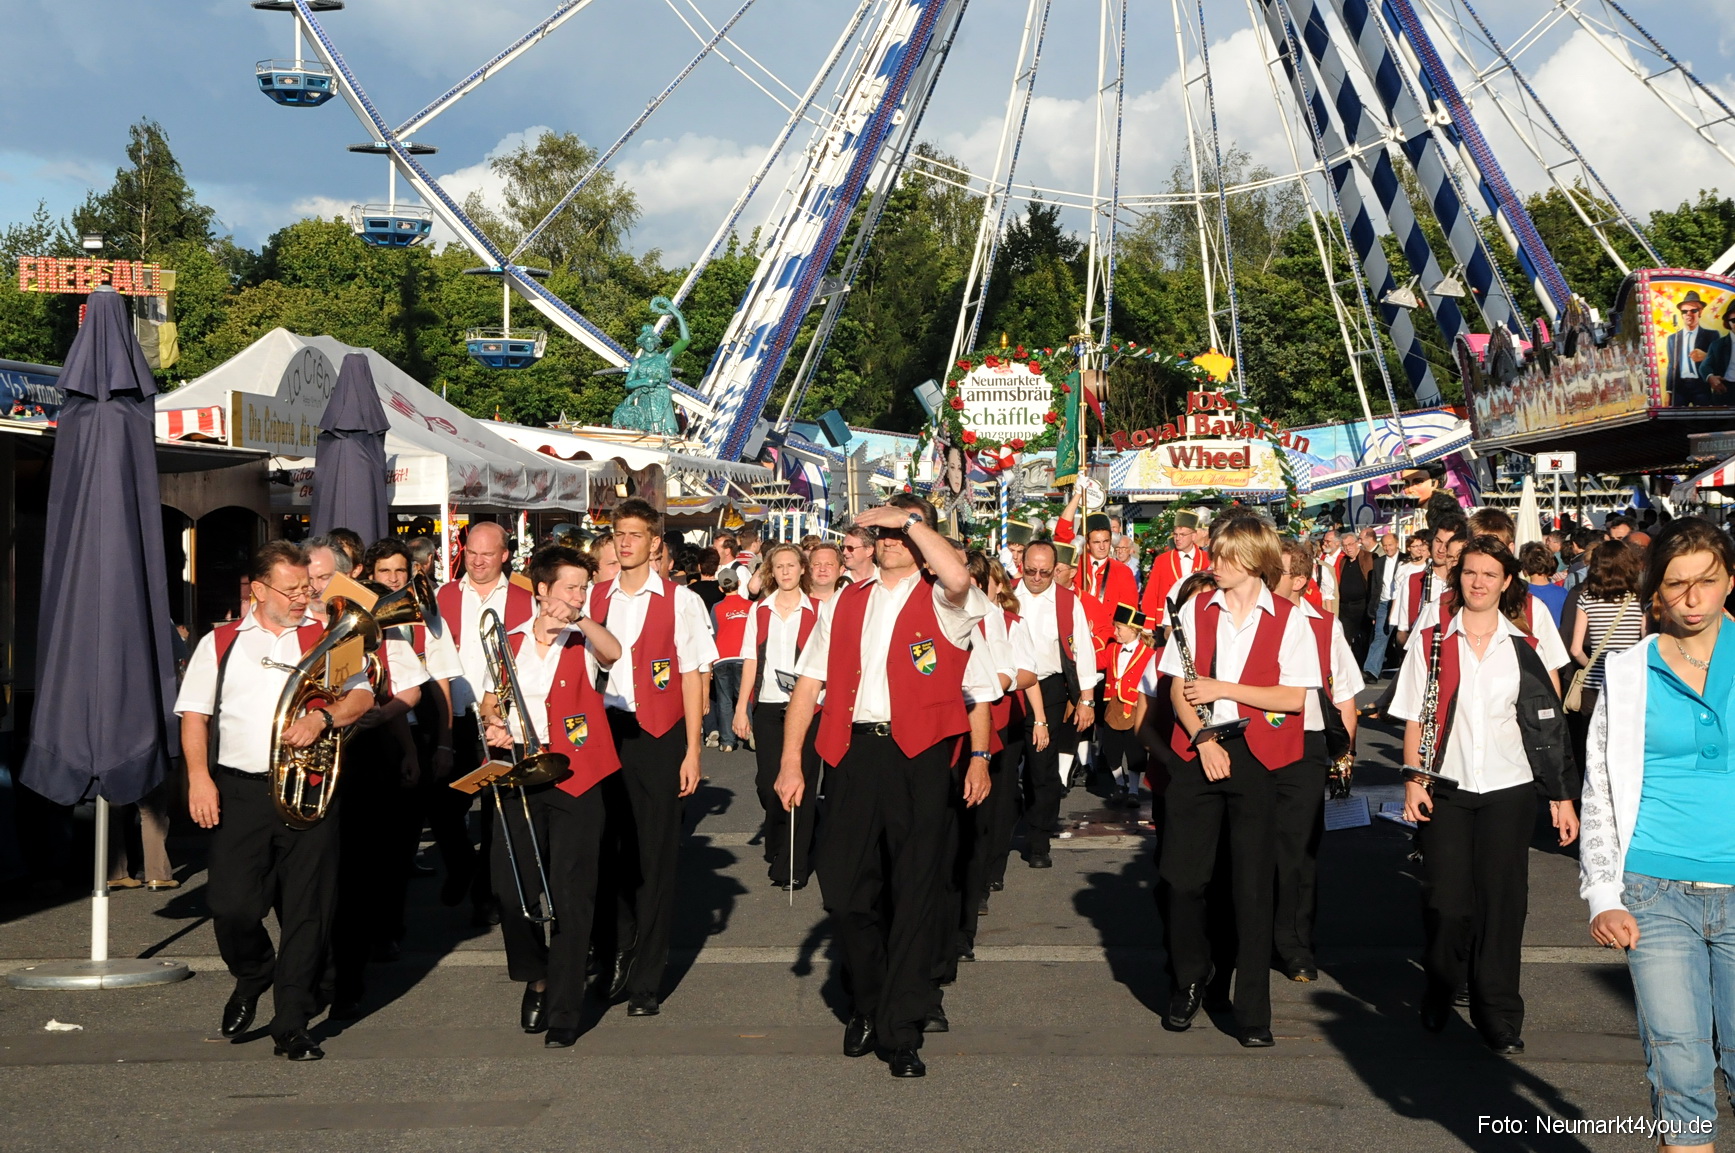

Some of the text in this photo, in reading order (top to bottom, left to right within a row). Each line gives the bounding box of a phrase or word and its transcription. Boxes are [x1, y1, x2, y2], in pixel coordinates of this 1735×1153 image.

[19, 256, 168, 297] FREEFALL
[971, 375, 1041, 387] Neumarkter
[959, 386, 1054, 402] Lammsbräu
[1185, 391, 1238, 415] JOS
[1110, 415, 1187, 454] Royal
[1166, 445, 1251, 469] Wheel
[1175, 473, 1247, 484] Herzlich Willkommen
